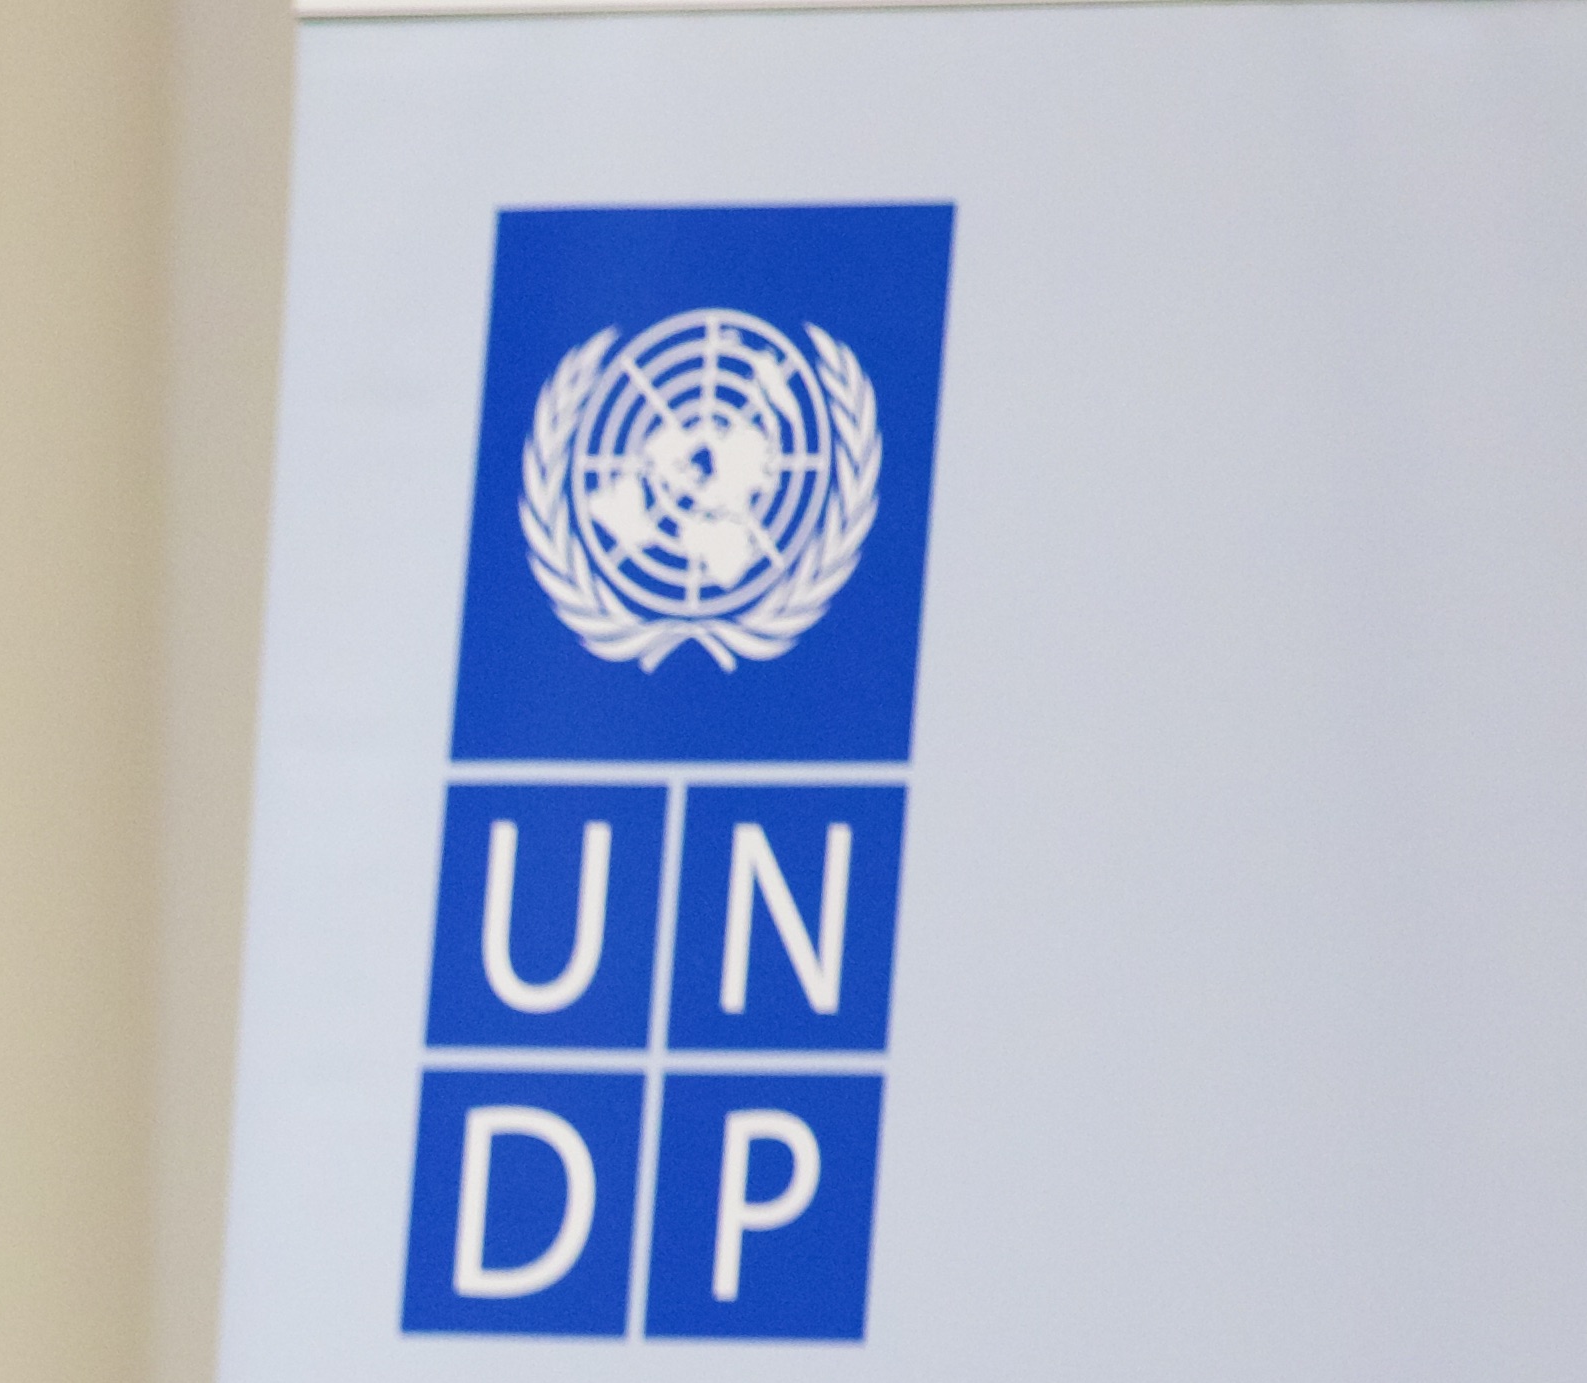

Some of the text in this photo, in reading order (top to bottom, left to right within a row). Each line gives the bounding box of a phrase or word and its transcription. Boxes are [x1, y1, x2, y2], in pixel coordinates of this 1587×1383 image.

[480, 818, 853, 1016] U N
[451, 1104, 822, 1303] D P
